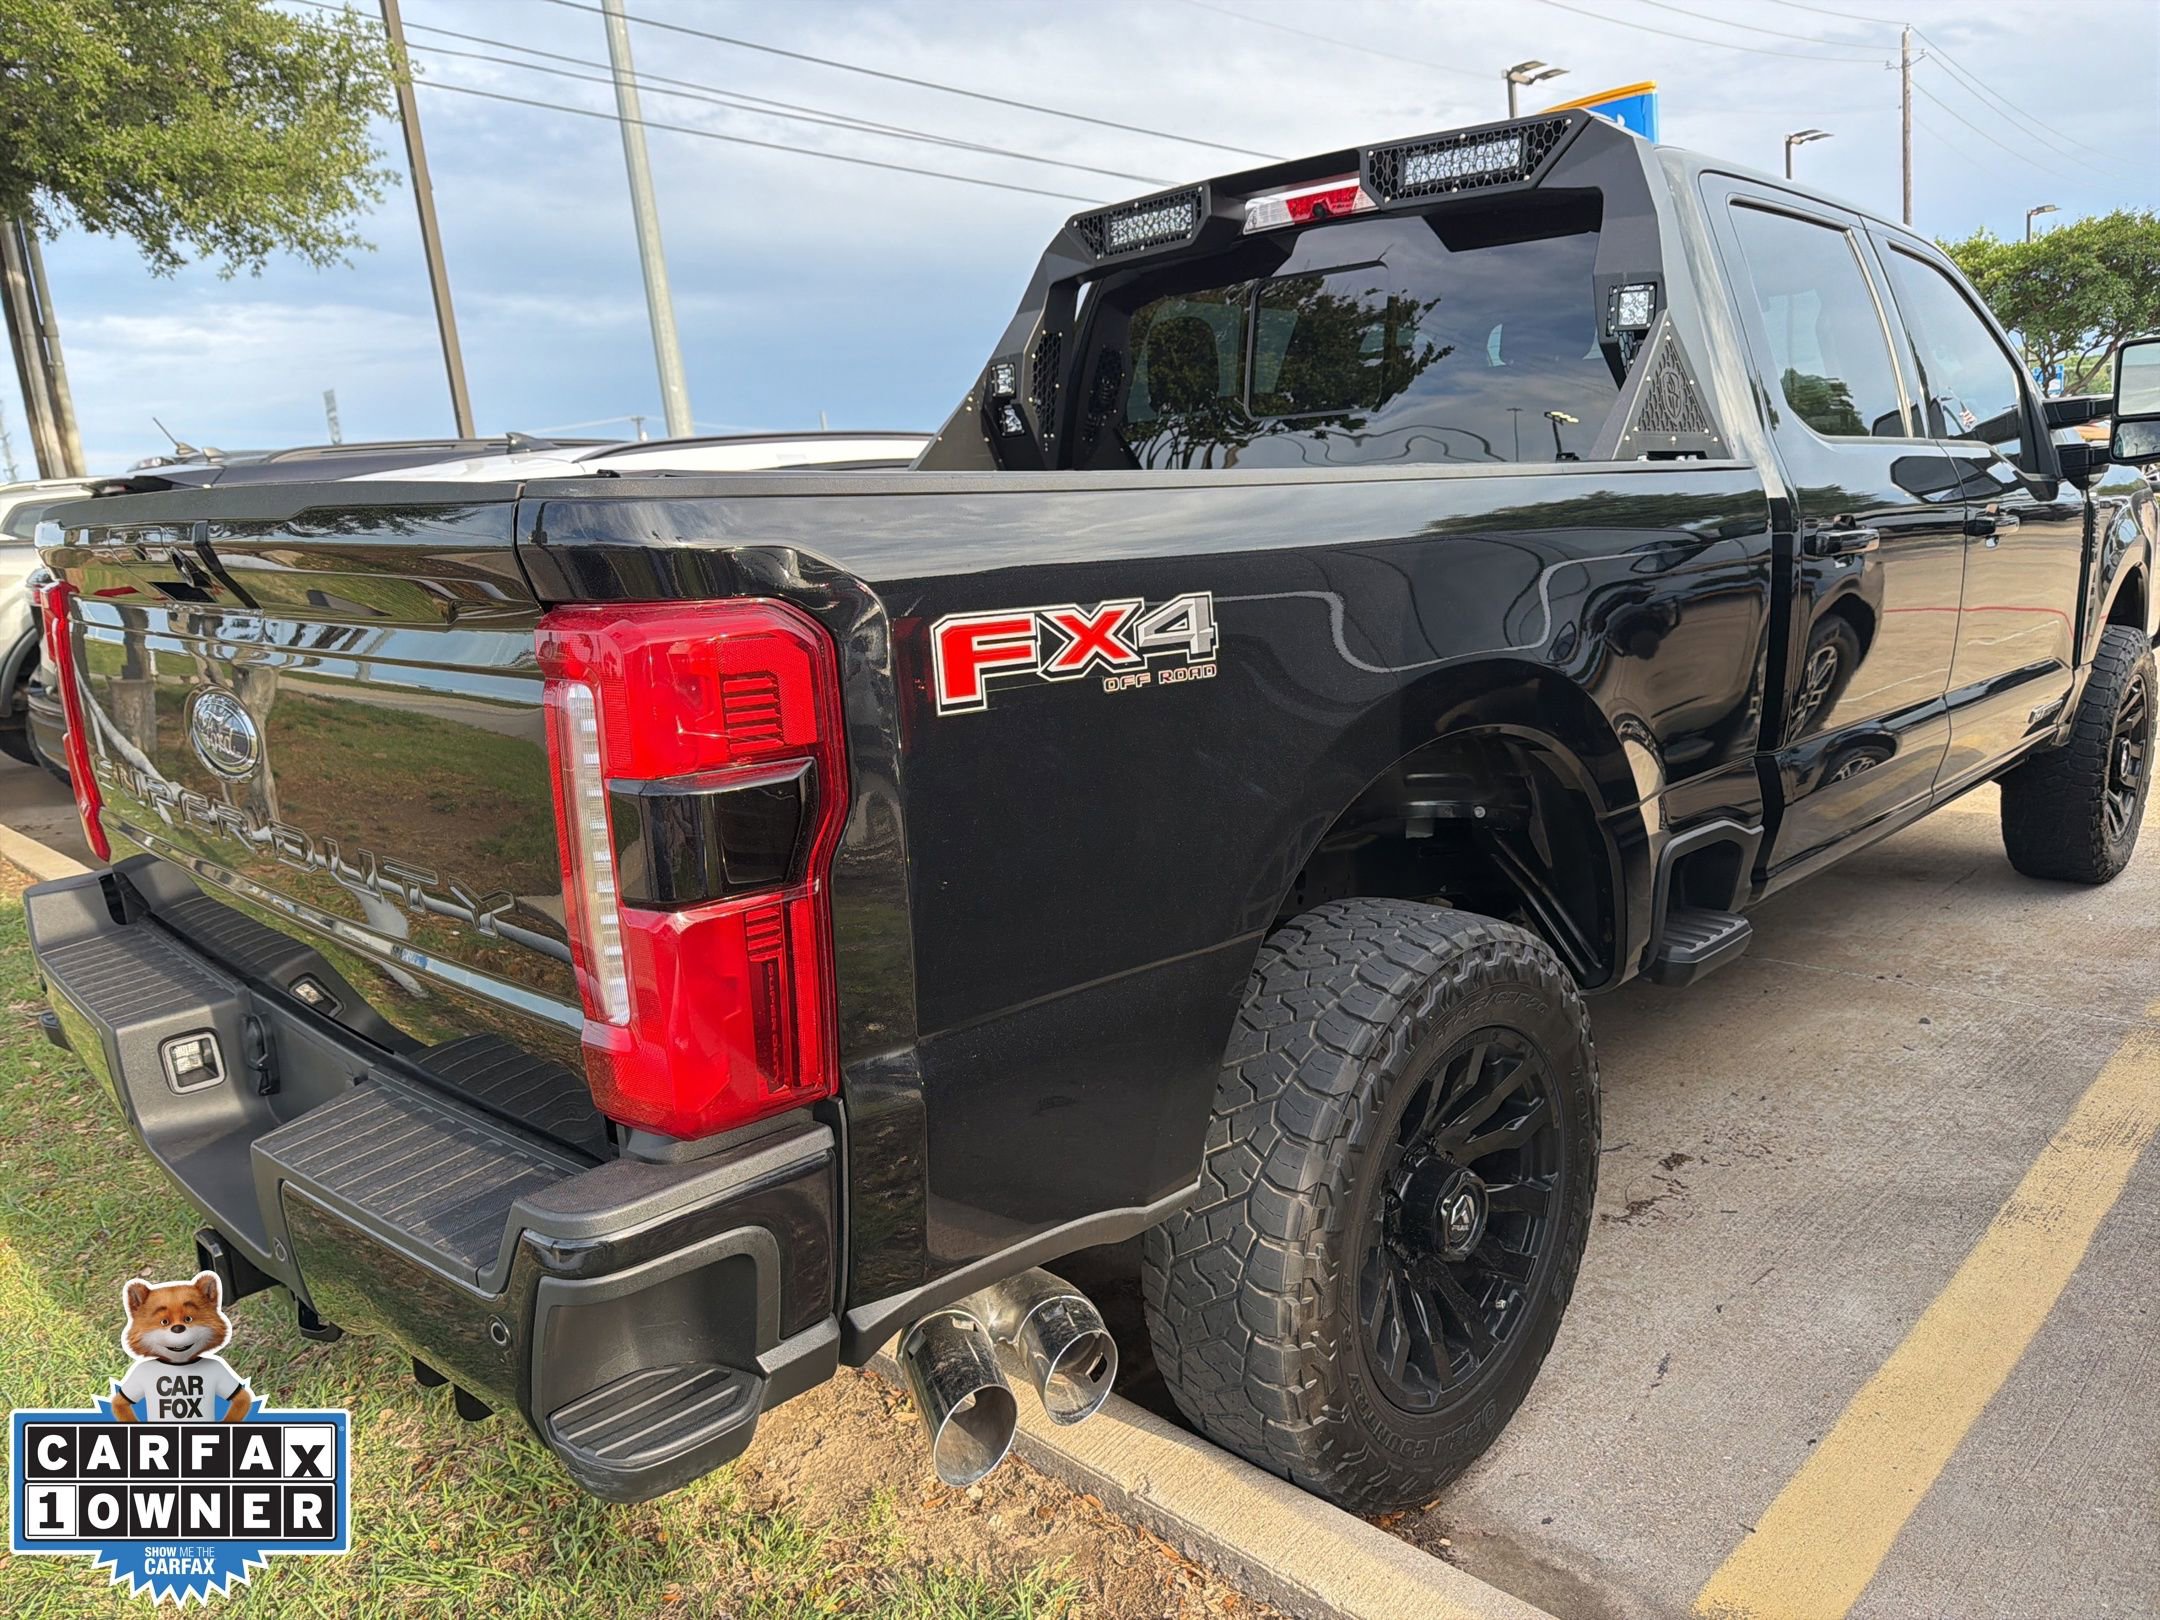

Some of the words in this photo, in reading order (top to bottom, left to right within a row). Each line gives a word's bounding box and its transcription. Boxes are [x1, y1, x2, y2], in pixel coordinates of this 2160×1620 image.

[930, 590, 1219, 716] FX4
[1103, 674, 1151, 692] OFF
[1158, 663, 1217, 684] ROAD
[199, 710, 245, 758] Ford
[96, 754, 258, 855] SUPER
[269, 817, 514, 938] DUTY
[1347, 1370, 1431, 1459] COUNTRY
[1431, 1398, 1498, 1458] OPEN
